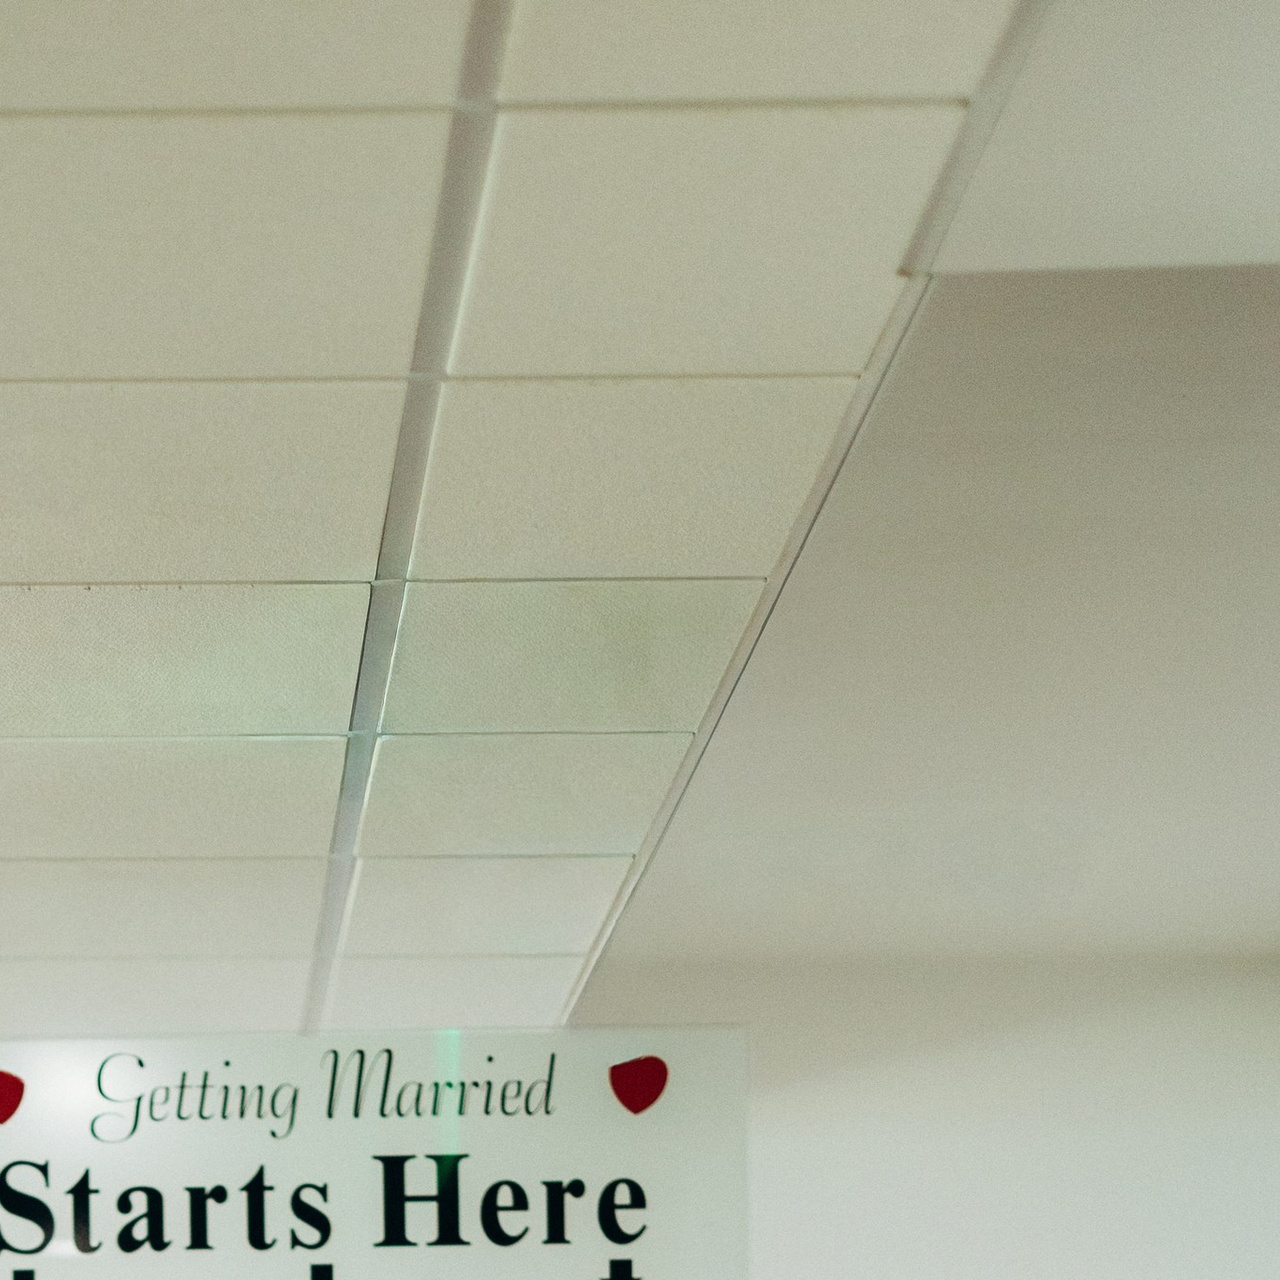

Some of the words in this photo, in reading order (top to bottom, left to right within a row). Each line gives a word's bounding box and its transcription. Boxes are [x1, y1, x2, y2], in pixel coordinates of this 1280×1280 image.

[90, 1052, 300, 1144] Getting
[321, 1048, 558, 1120] Married
[373, 1153, 648, 1248] Here
